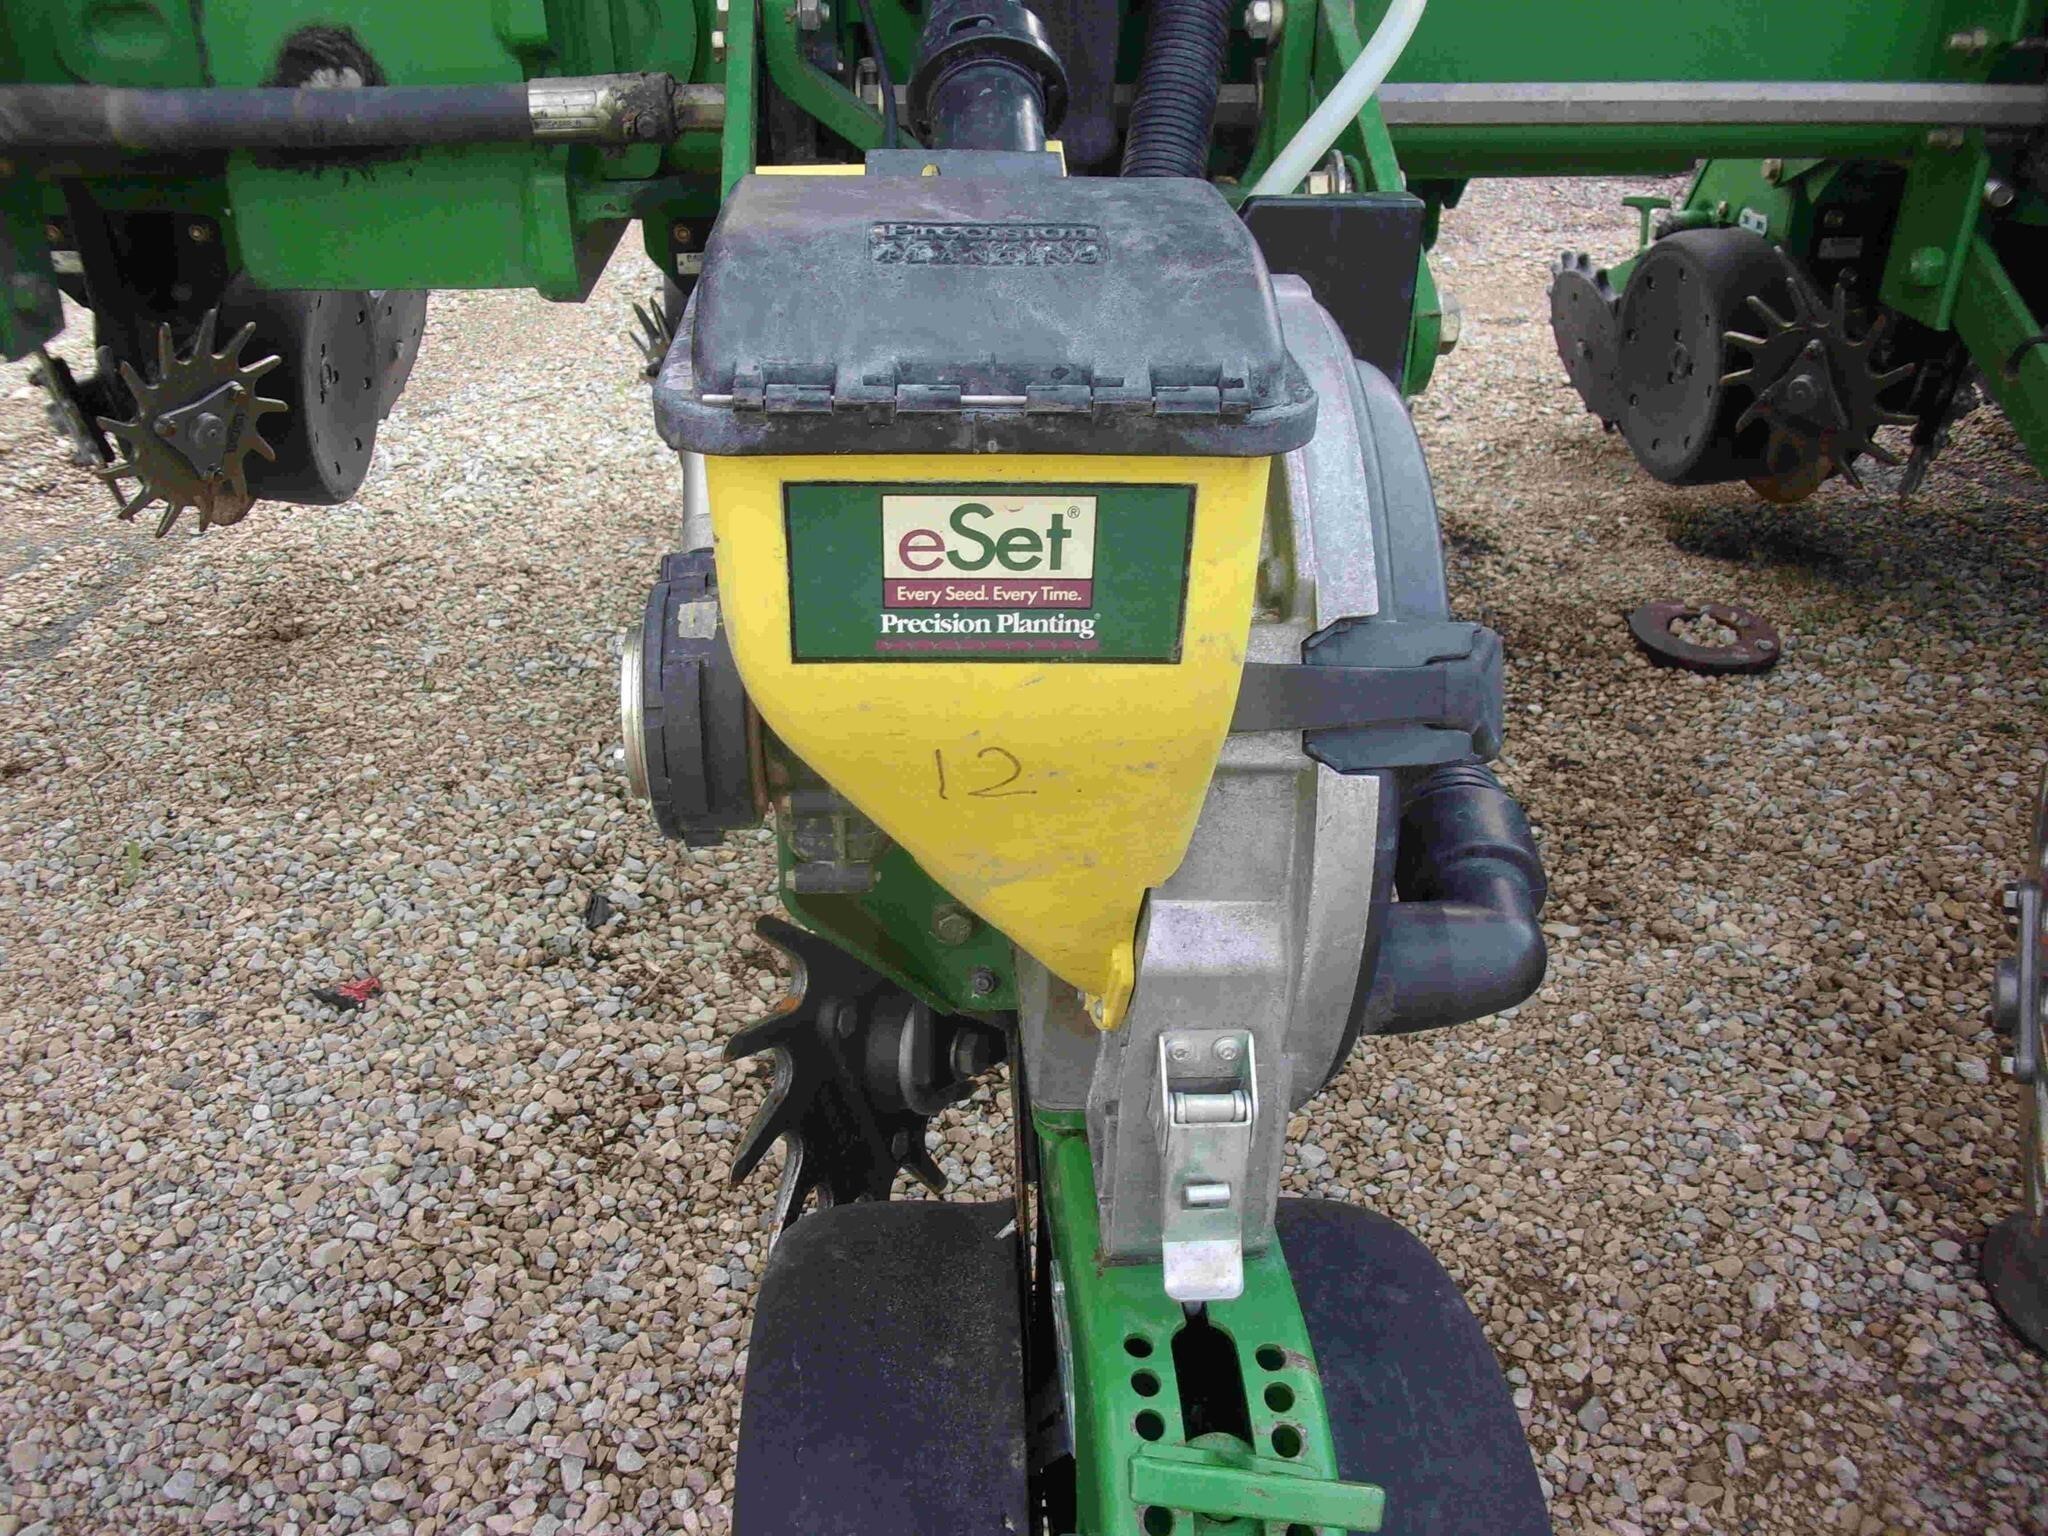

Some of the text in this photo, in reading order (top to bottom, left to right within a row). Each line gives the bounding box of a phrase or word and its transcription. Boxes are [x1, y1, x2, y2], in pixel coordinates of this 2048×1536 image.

[897, 585, 1082, 605] Every Seed. Every Time.
[880, 612, 1096, 639] Precision Planting
[935, 746, 1037, 800] 12
